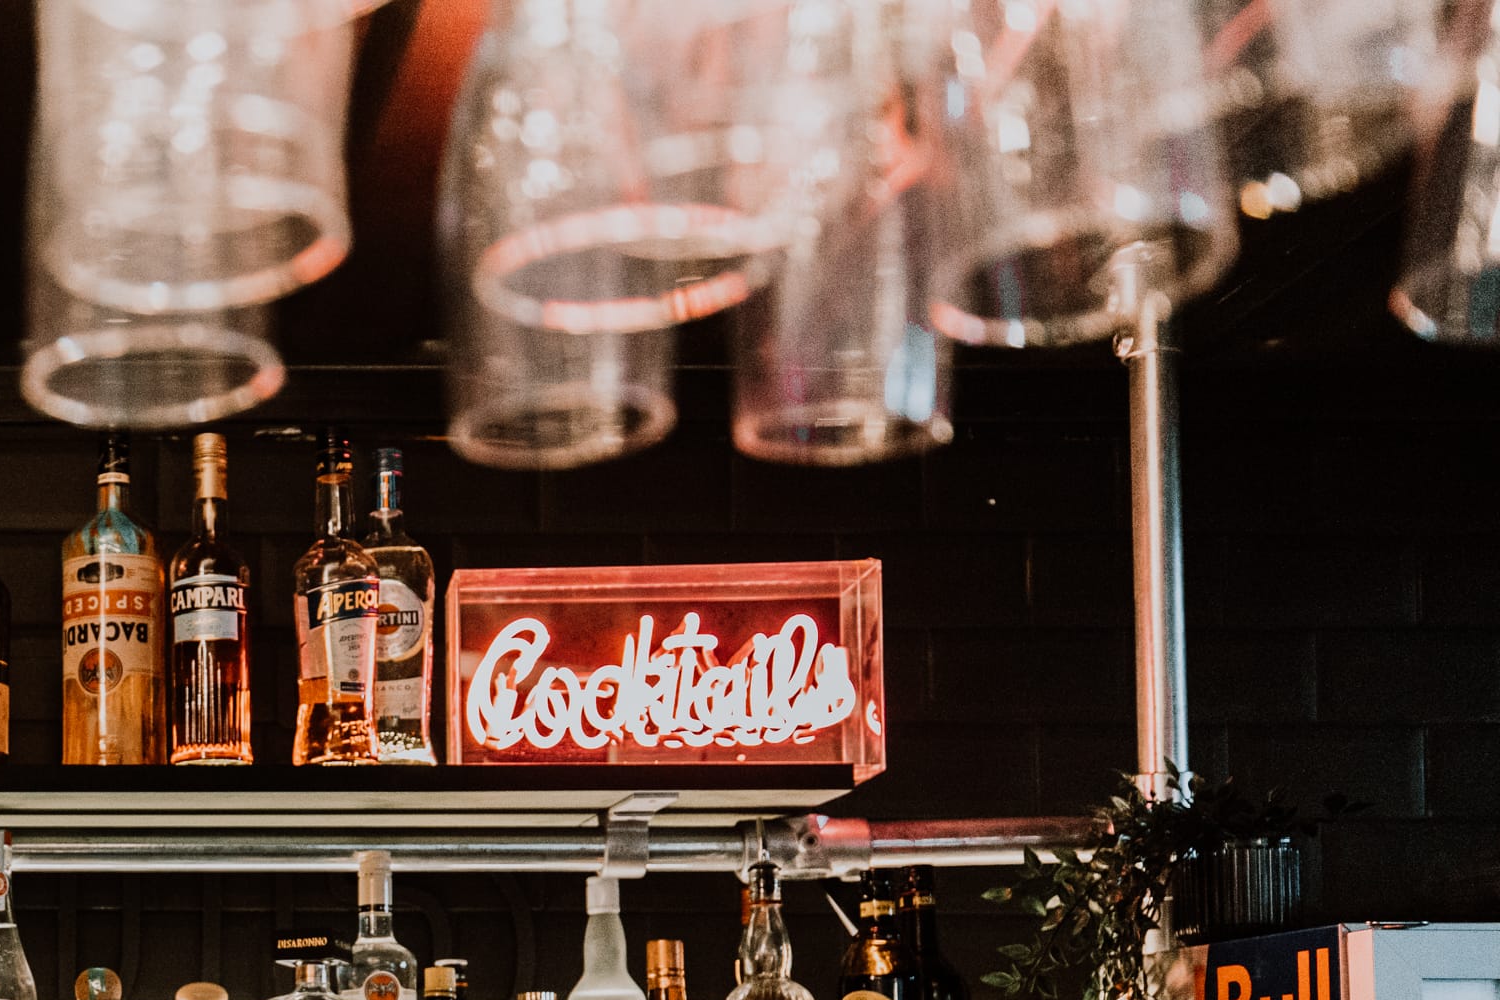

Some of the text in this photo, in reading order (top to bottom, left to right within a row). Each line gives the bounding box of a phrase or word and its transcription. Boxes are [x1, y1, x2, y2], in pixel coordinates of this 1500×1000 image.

[65, 594, 144, 615] SPICED
[171, 586, 244, 613] CAMPARI
[378, 612, 417, 625] RTINI
[467, 612, 857, 752] Cocktails
[277, 937, 328, 949] DISARONNO
